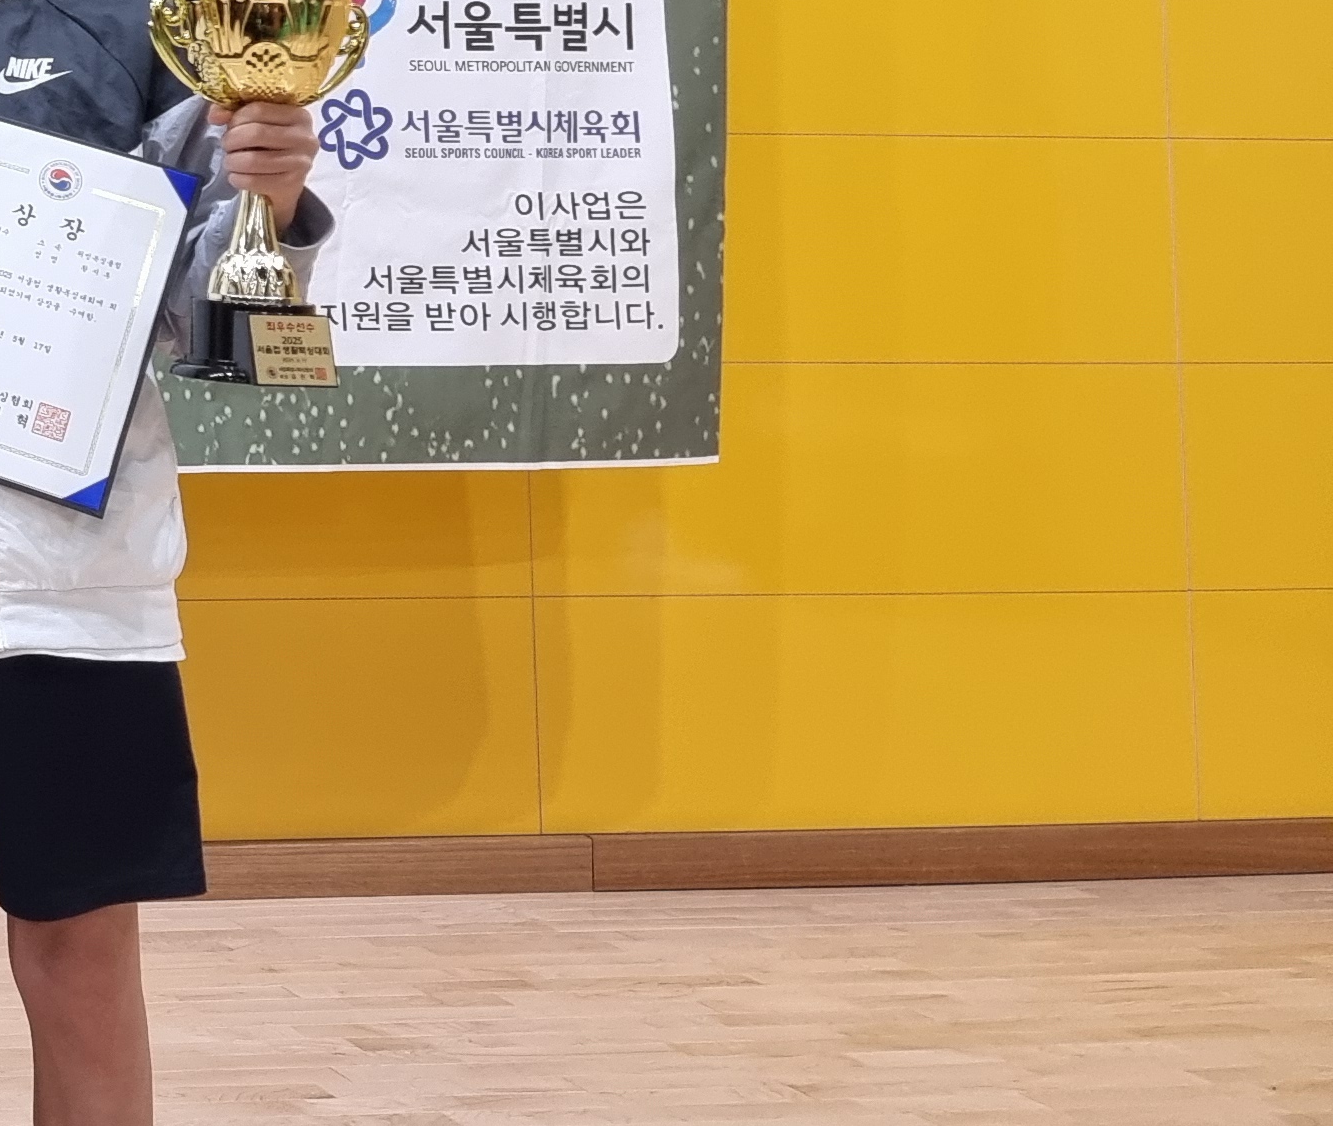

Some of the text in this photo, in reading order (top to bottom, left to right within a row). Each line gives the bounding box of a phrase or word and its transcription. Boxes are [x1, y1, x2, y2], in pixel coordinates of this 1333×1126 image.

[406, 0, 634, 52] 서울특별시
[5, 56, 55, 80] NIKE
[409, 59, 635, 73] SEOUL METROPOLITAN GOVERNMENT
[401, 109, 641, 144] 서울특별시체육회
[404, 147, 439, 159] SEOUL
[440, 147, 481, 159] SPORTS
[484, 147, 526, 159] COUNCIL
[536, 147, 564, 159] KOREA
[565, 147, 598, 159] SPORT
[601, 148, 642, 159] LEADER
[461, 228, 651, 257] 서울특별시와
[363, 264, 650, 295] 서울특별시체육회의
[266, 321, 315, 333] 최우수선수
[320, 300, 664, 332] 지원을 받아 시행합니다.
[281, 336, 303, 345] 2025
